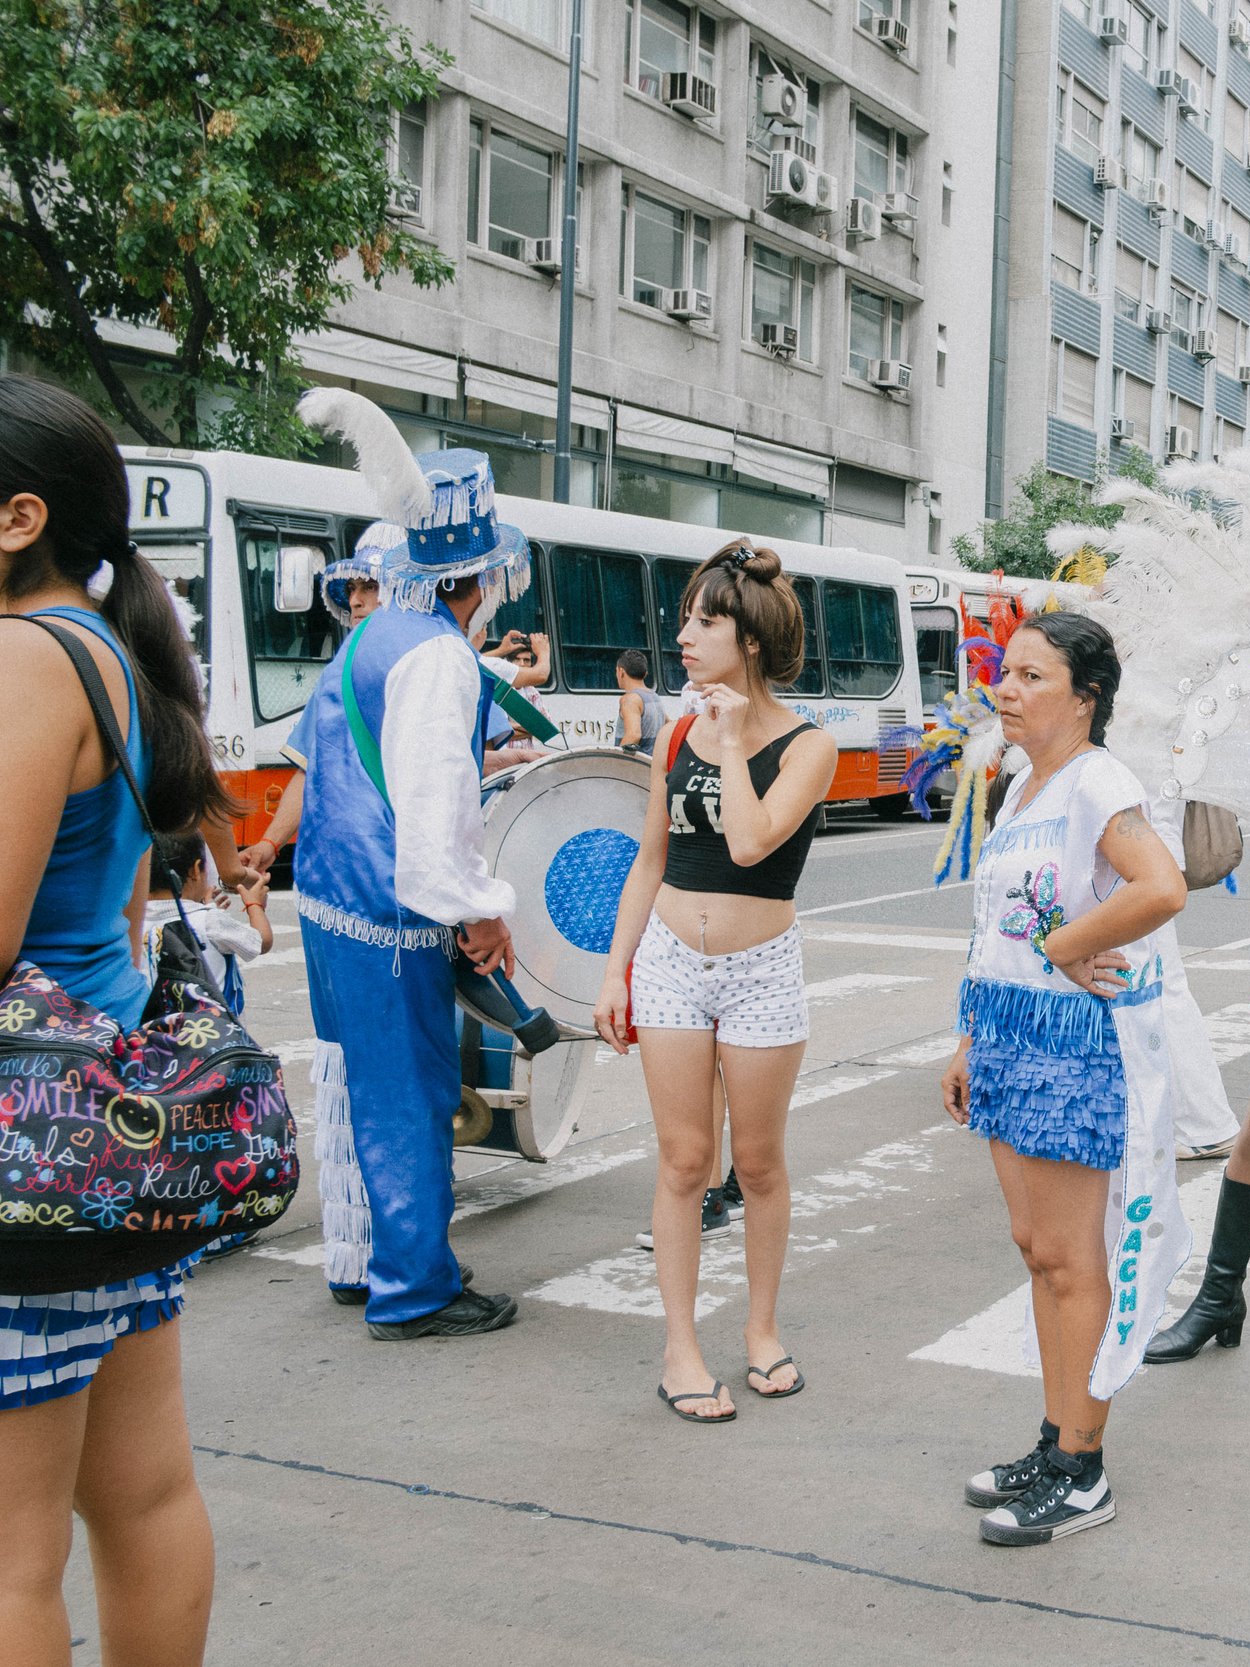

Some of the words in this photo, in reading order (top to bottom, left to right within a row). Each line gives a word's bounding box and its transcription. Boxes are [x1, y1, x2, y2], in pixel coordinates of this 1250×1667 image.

[686, 775, 722, 794] C'ES
[0, 1053, 62, 1078] mile
[0, 1078, 108, 1123] SMILE
[171, 1131, 236, 1152] HOPE
[139, 1162, 223, 1198] Rule
[0, 1197, 75, 1226] eace
